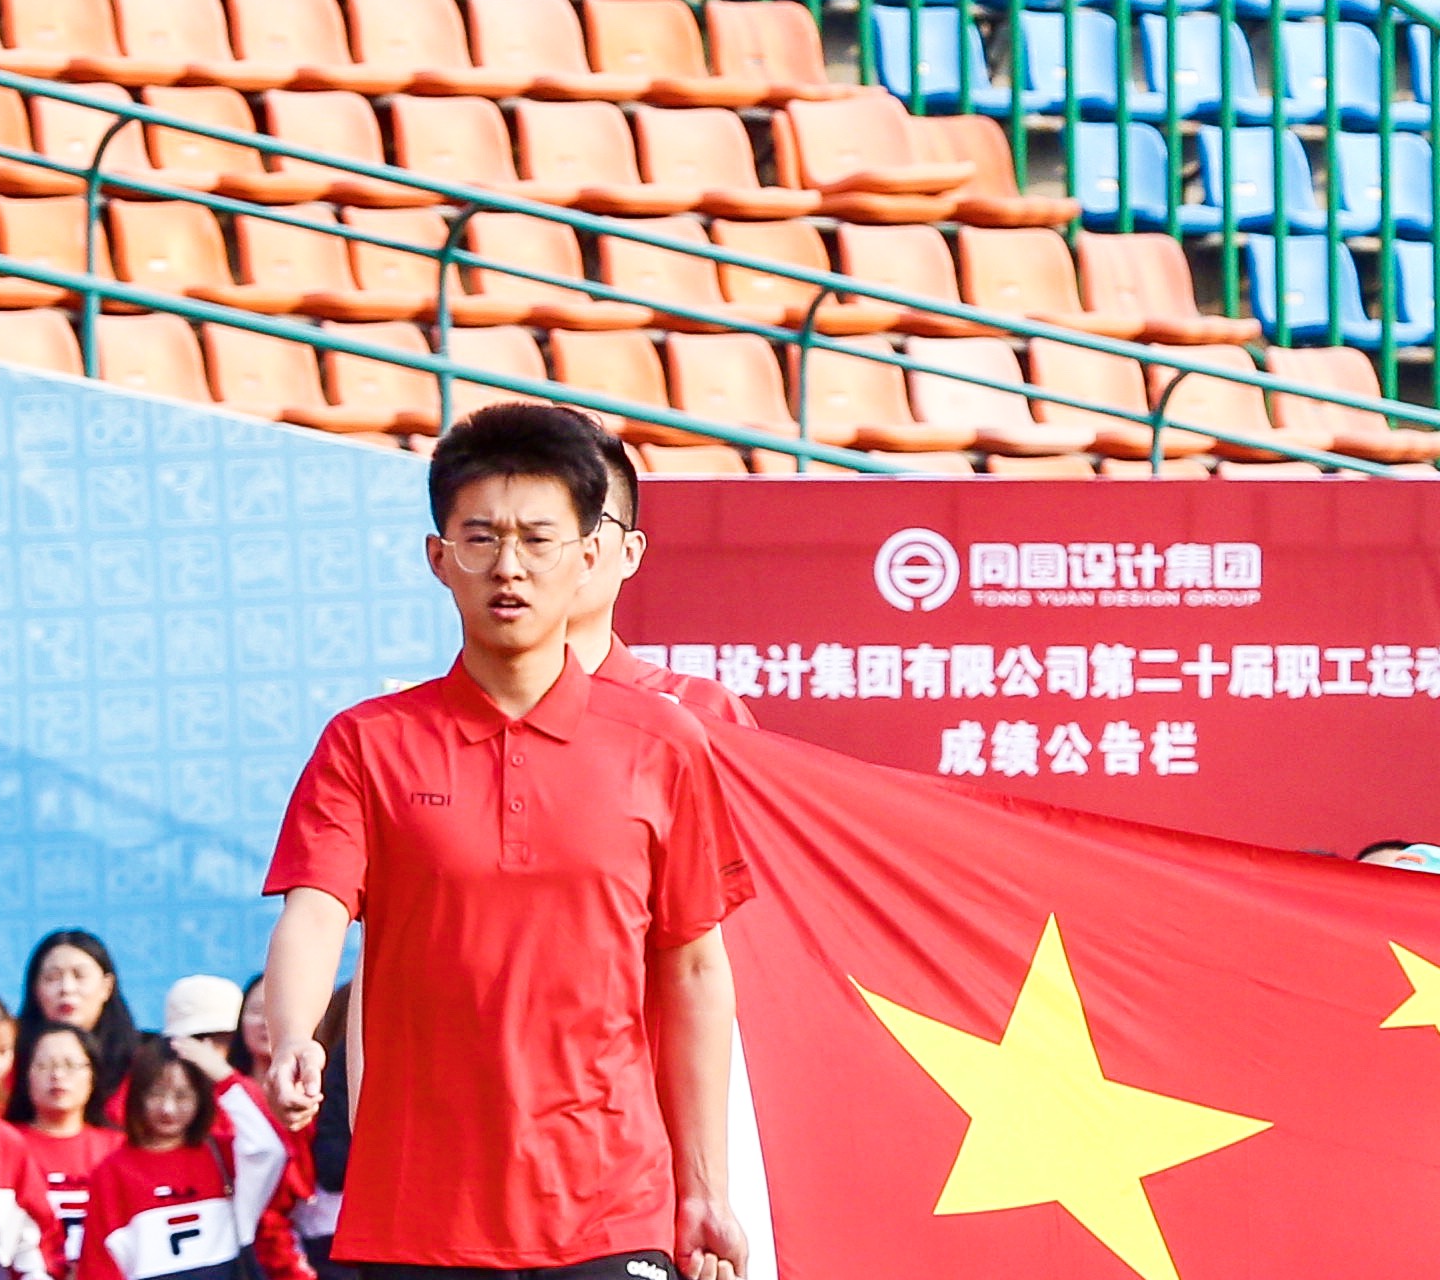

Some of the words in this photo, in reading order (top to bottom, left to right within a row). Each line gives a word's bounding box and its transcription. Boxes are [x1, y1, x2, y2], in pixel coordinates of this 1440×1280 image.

[971, 590, 1032, 607] TONG
[1035, 590, 1095, 607] YUAN
[1098, 590, 1181, 607] DESIGN
[1183, 590, 1262, 607] GROUP
[938, 719, 1200, 777] 成绩公告栏
